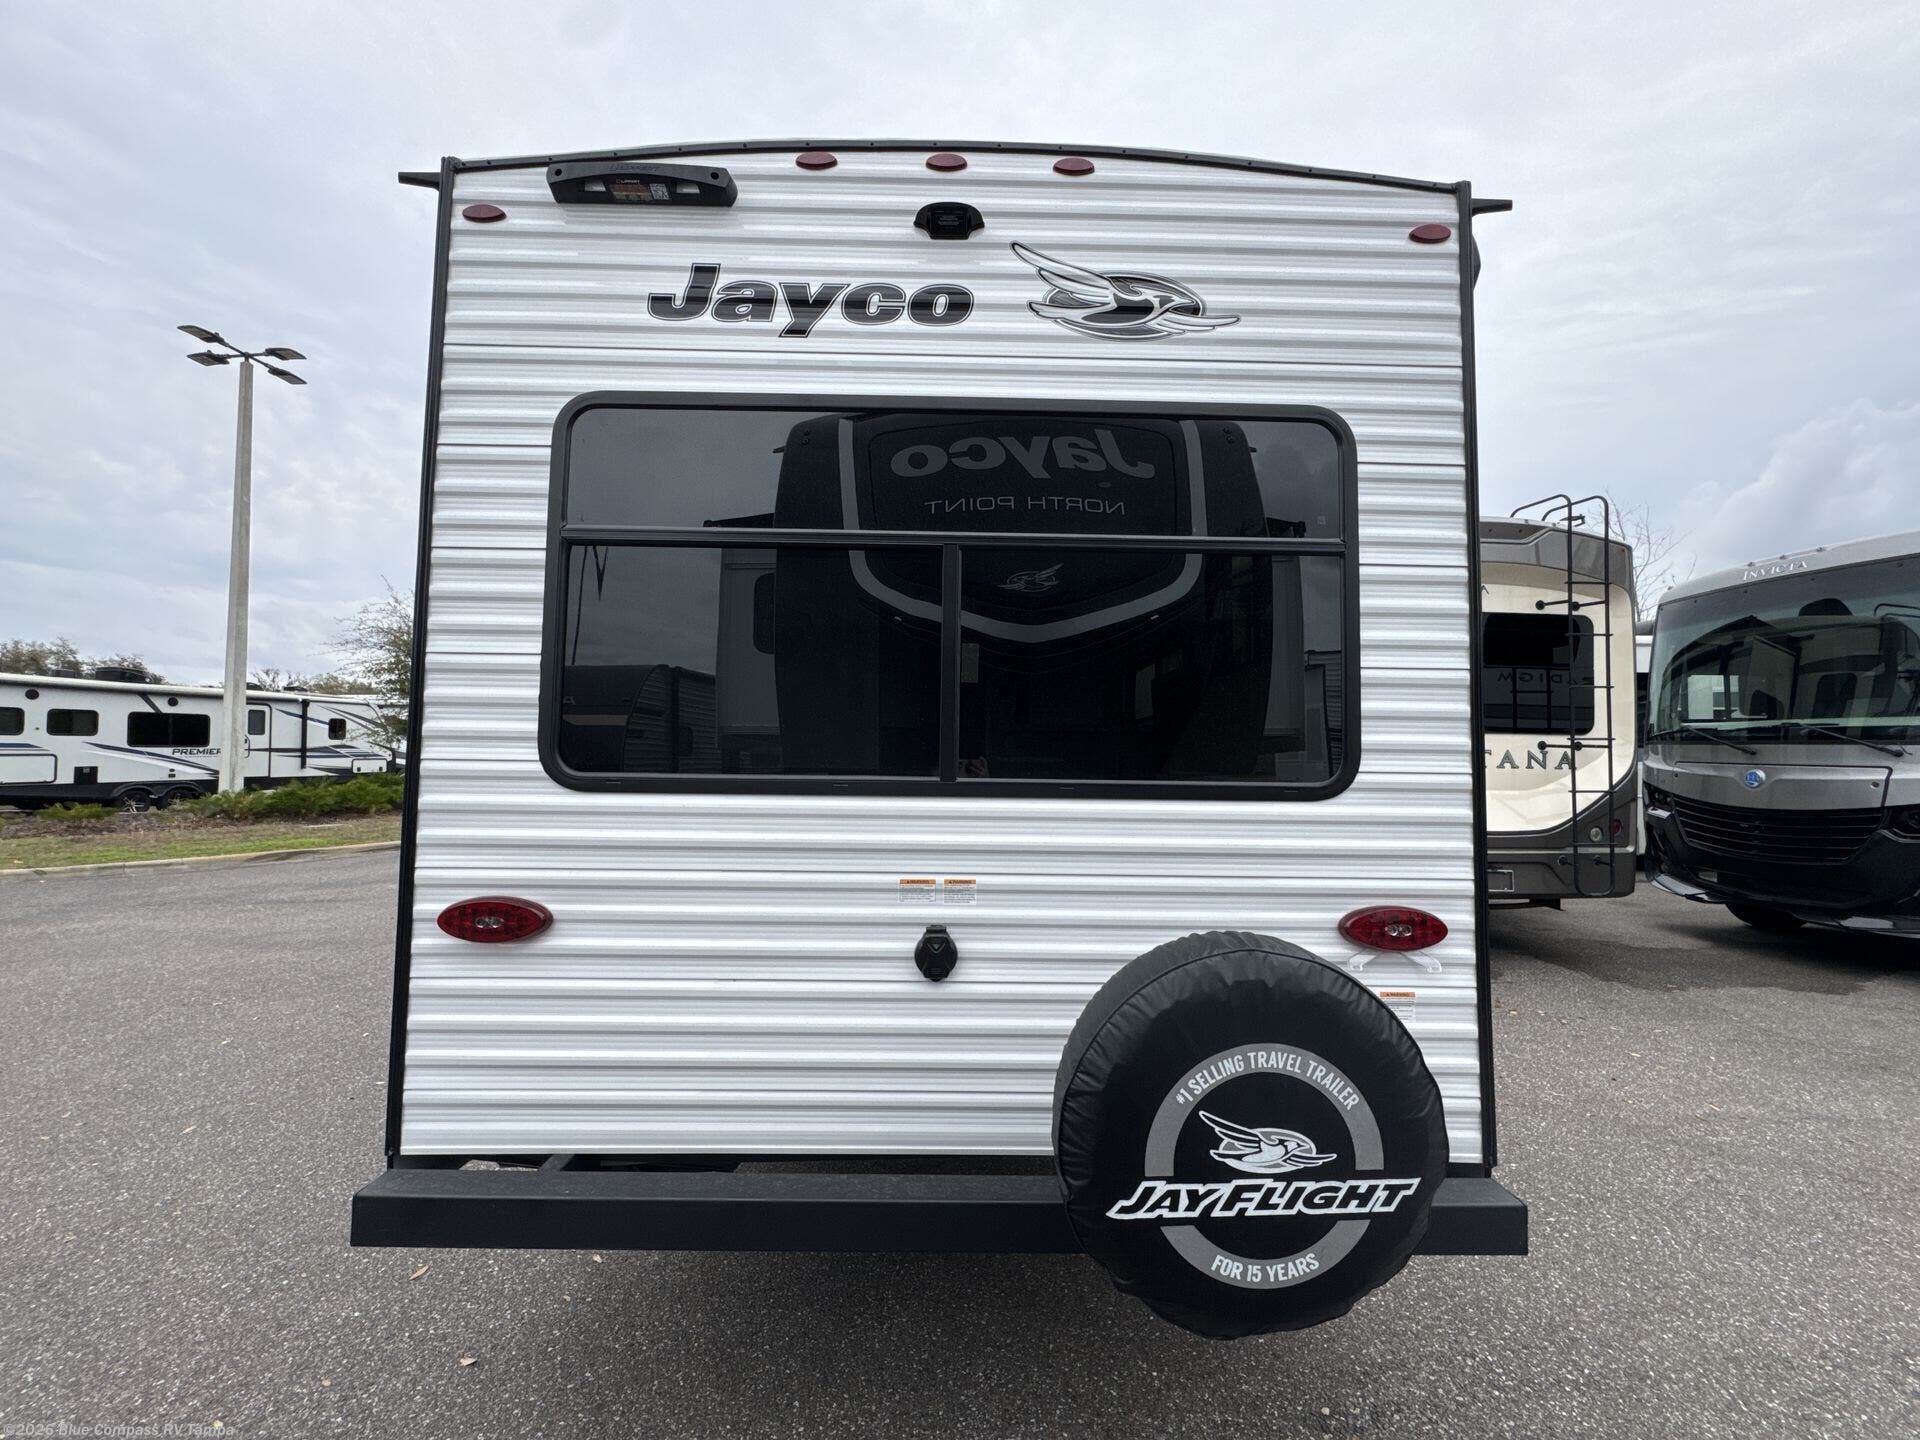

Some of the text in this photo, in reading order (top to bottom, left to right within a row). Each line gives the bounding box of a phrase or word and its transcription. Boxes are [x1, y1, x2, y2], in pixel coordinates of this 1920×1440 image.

[646, 262, 975, 338] Jayco
[1175, 1051, 1360, 1111] #1 SELLING TRAVEL TRAILER
[1210, 1252, 1320, 1283] FOR 15 YEARS
